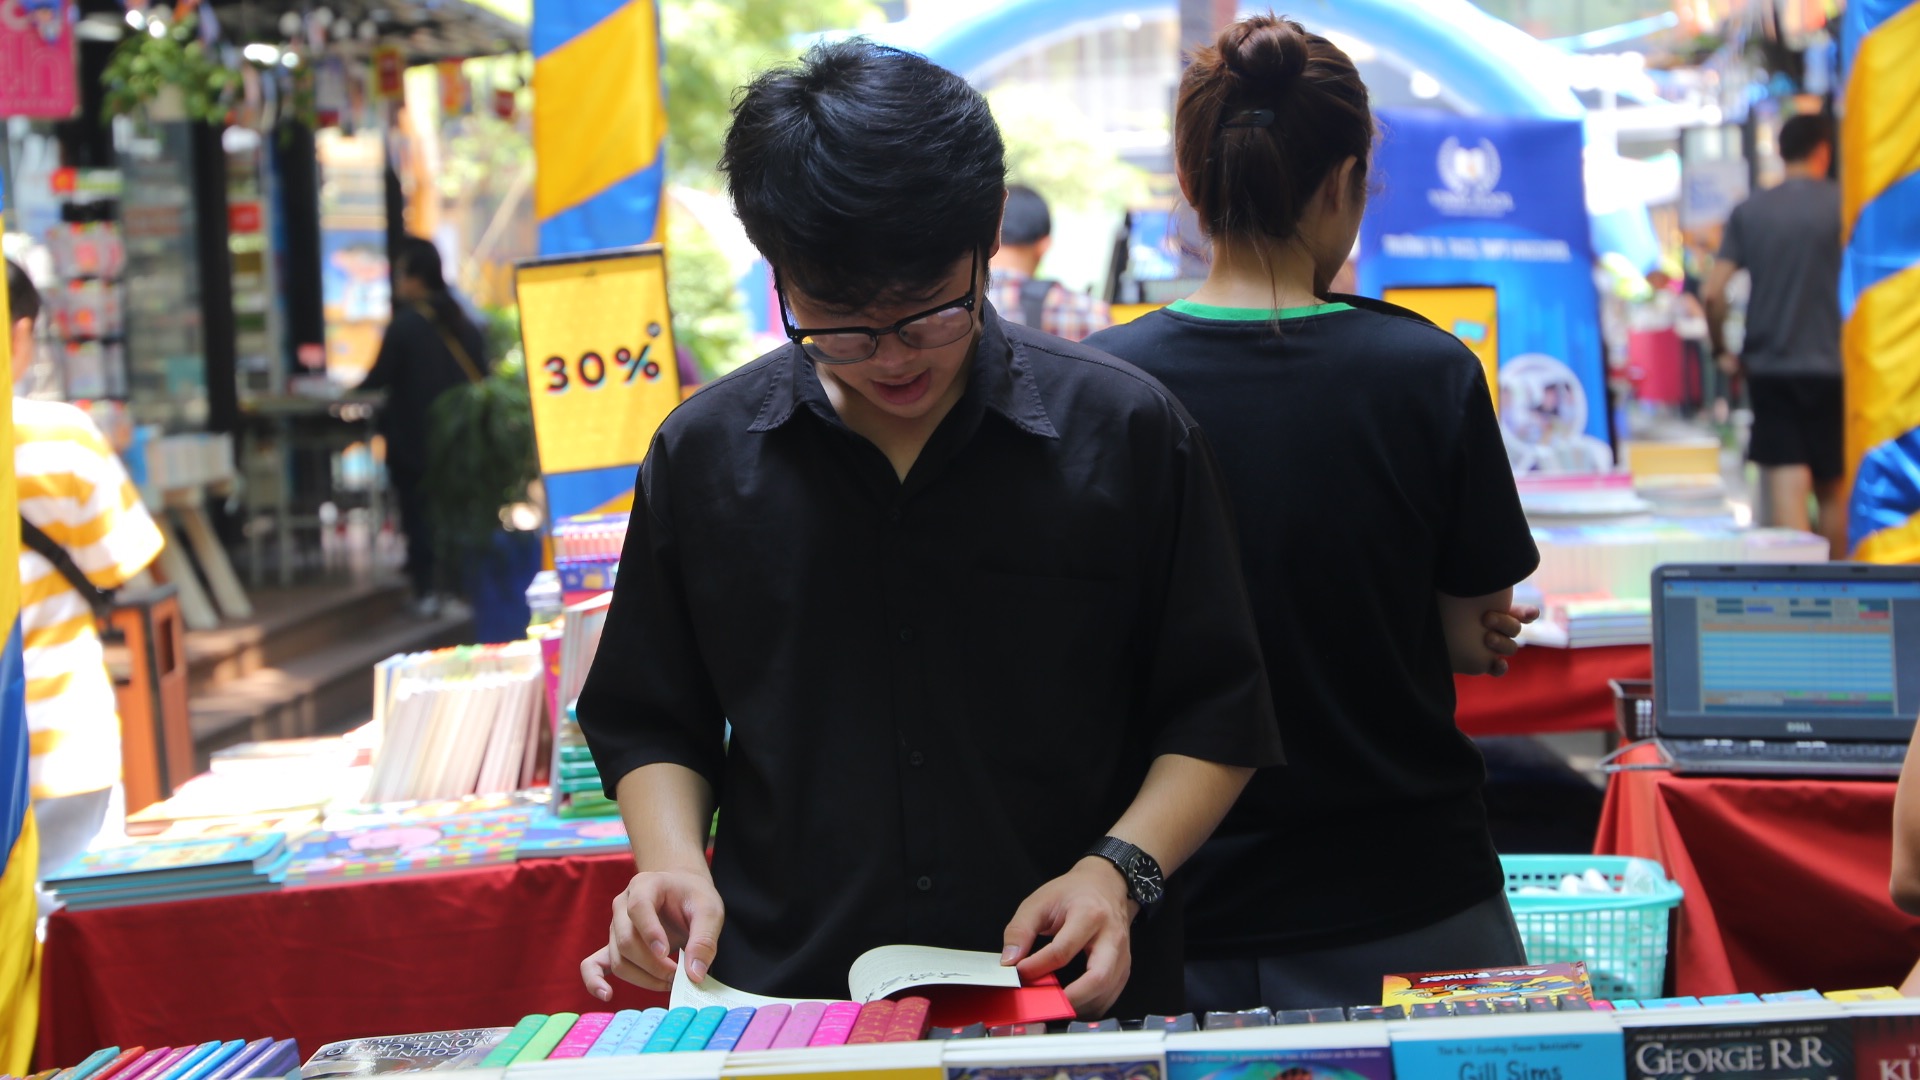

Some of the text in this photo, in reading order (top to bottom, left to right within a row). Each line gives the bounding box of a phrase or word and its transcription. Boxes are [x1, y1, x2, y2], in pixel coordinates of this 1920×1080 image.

[543, 344, 660, 392] 30%
[382, 1047, 464, 1058] COUNT
[411, 1036, 494, 1050] MONTE
[1634, 1041, 1765, 1076] GEORGE
[1458, 1060, 1562, 1080] Gill Sims
